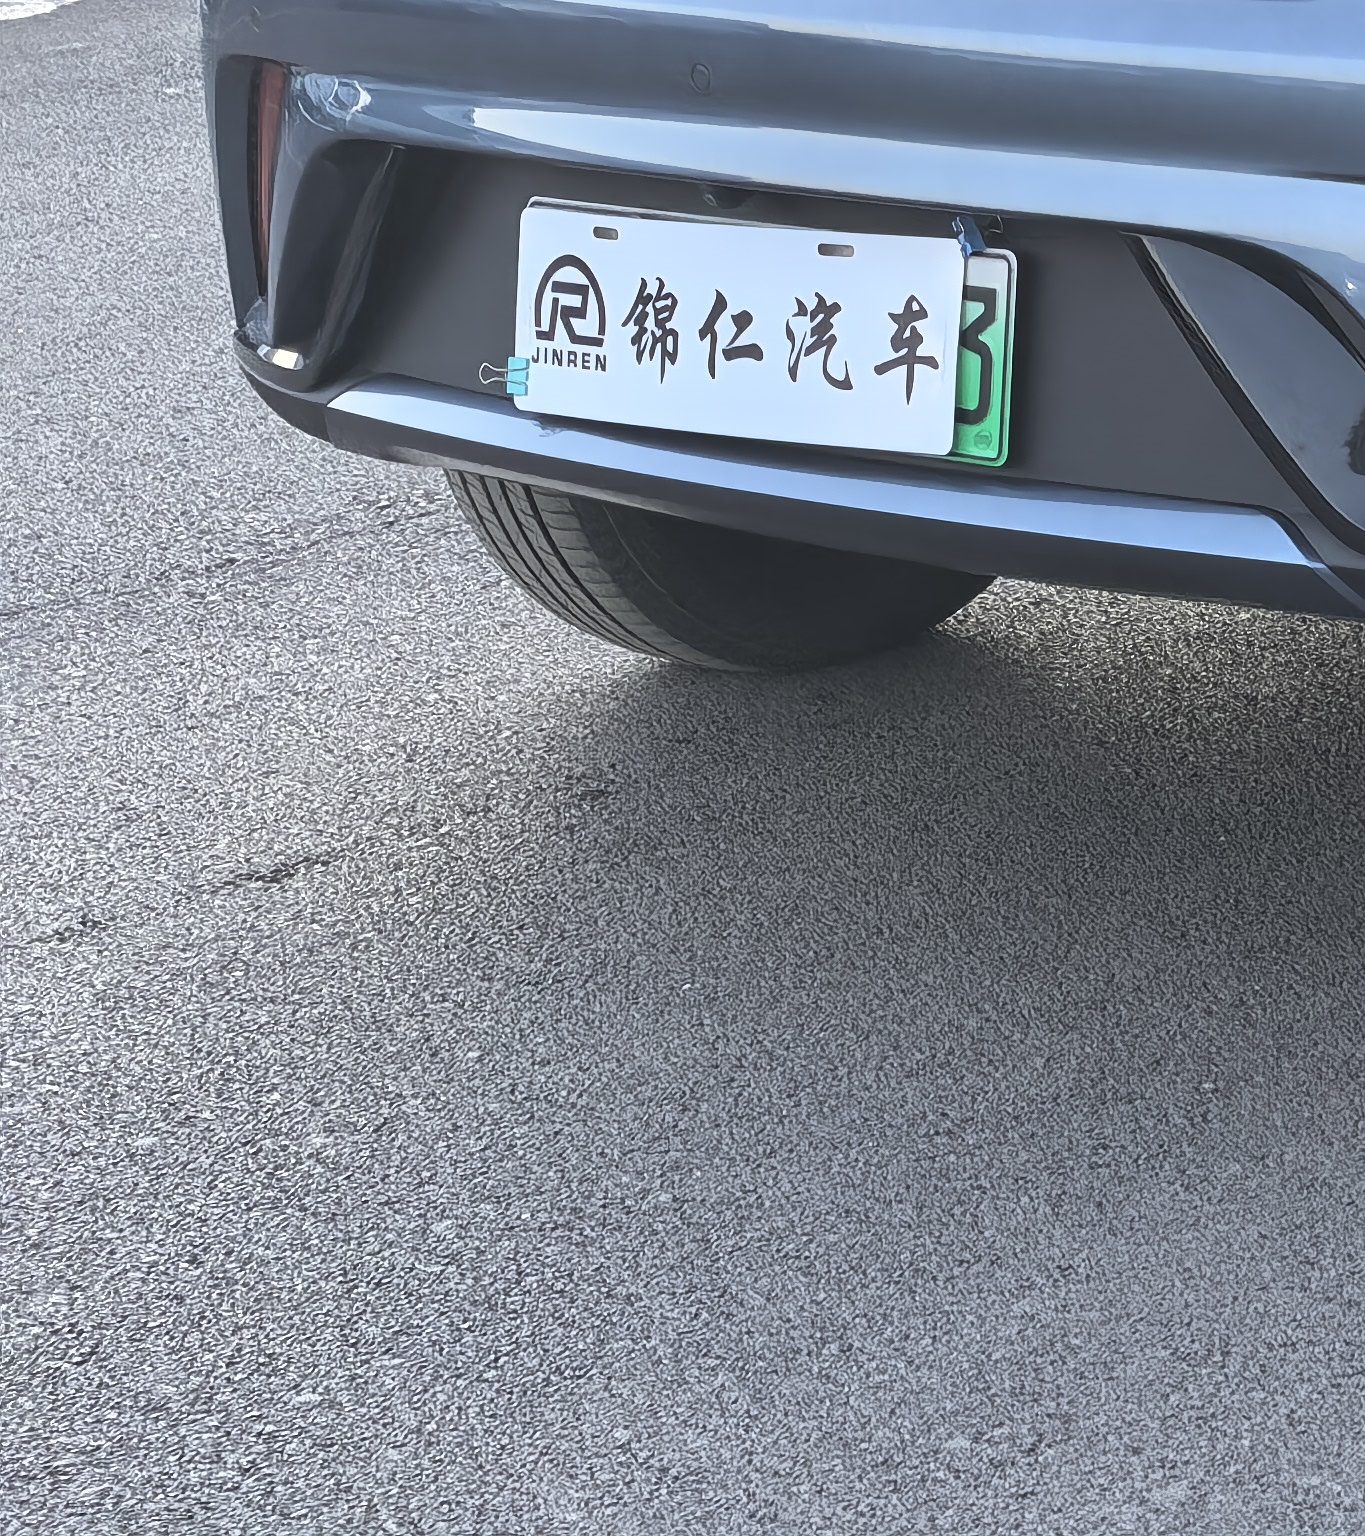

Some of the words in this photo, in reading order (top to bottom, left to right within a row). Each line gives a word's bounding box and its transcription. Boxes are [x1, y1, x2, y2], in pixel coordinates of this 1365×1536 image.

[531, 346, 607, 373] JINREN
[620, 276, 940, 405] 锦仁汽车
